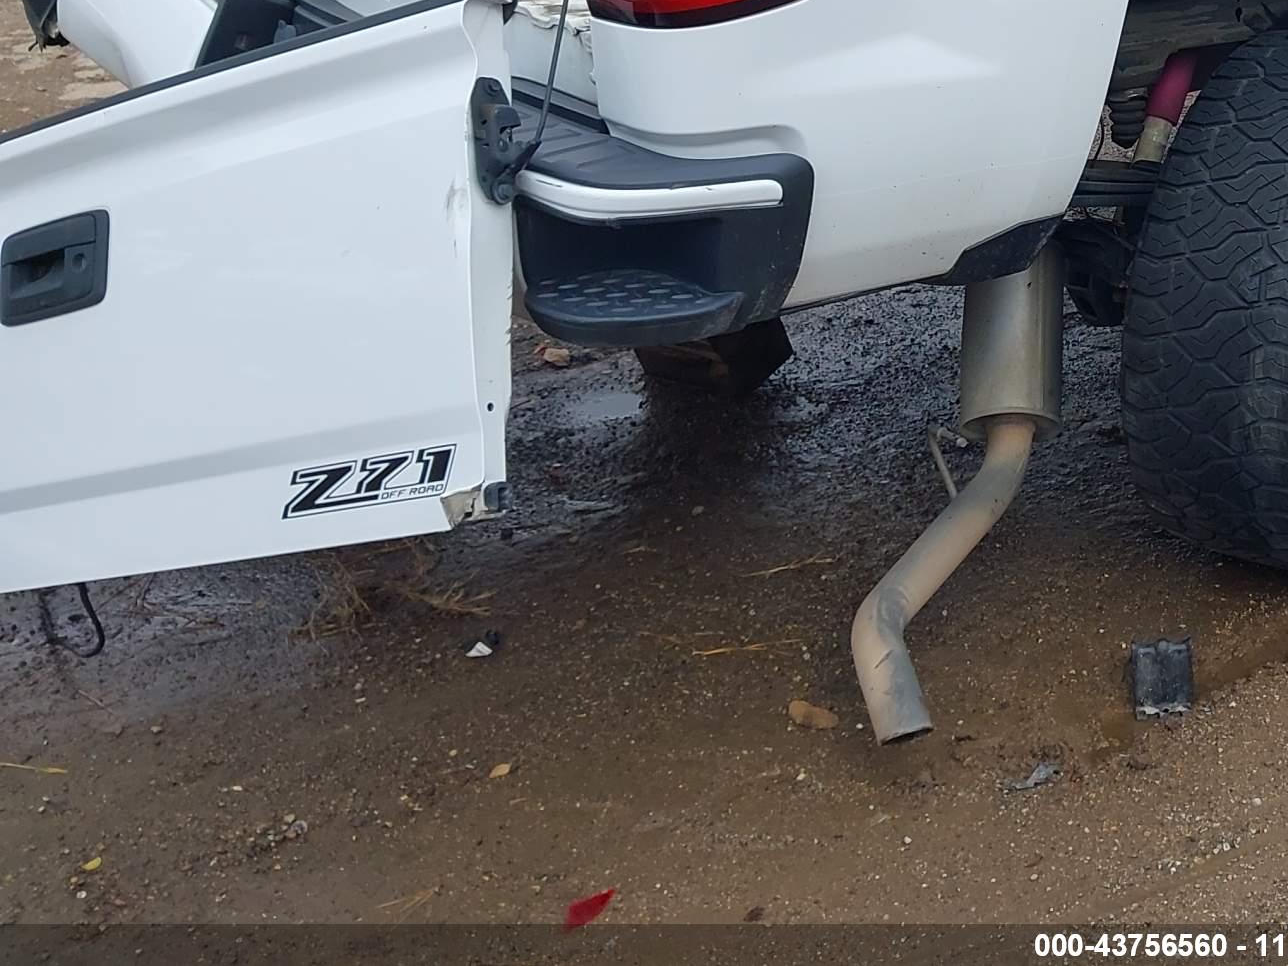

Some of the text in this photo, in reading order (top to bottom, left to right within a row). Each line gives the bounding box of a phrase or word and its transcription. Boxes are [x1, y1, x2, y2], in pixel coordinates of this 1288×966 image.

[282, 443, 457, 519] Z71
[381, 483, 444, 500] OFF ROAD
